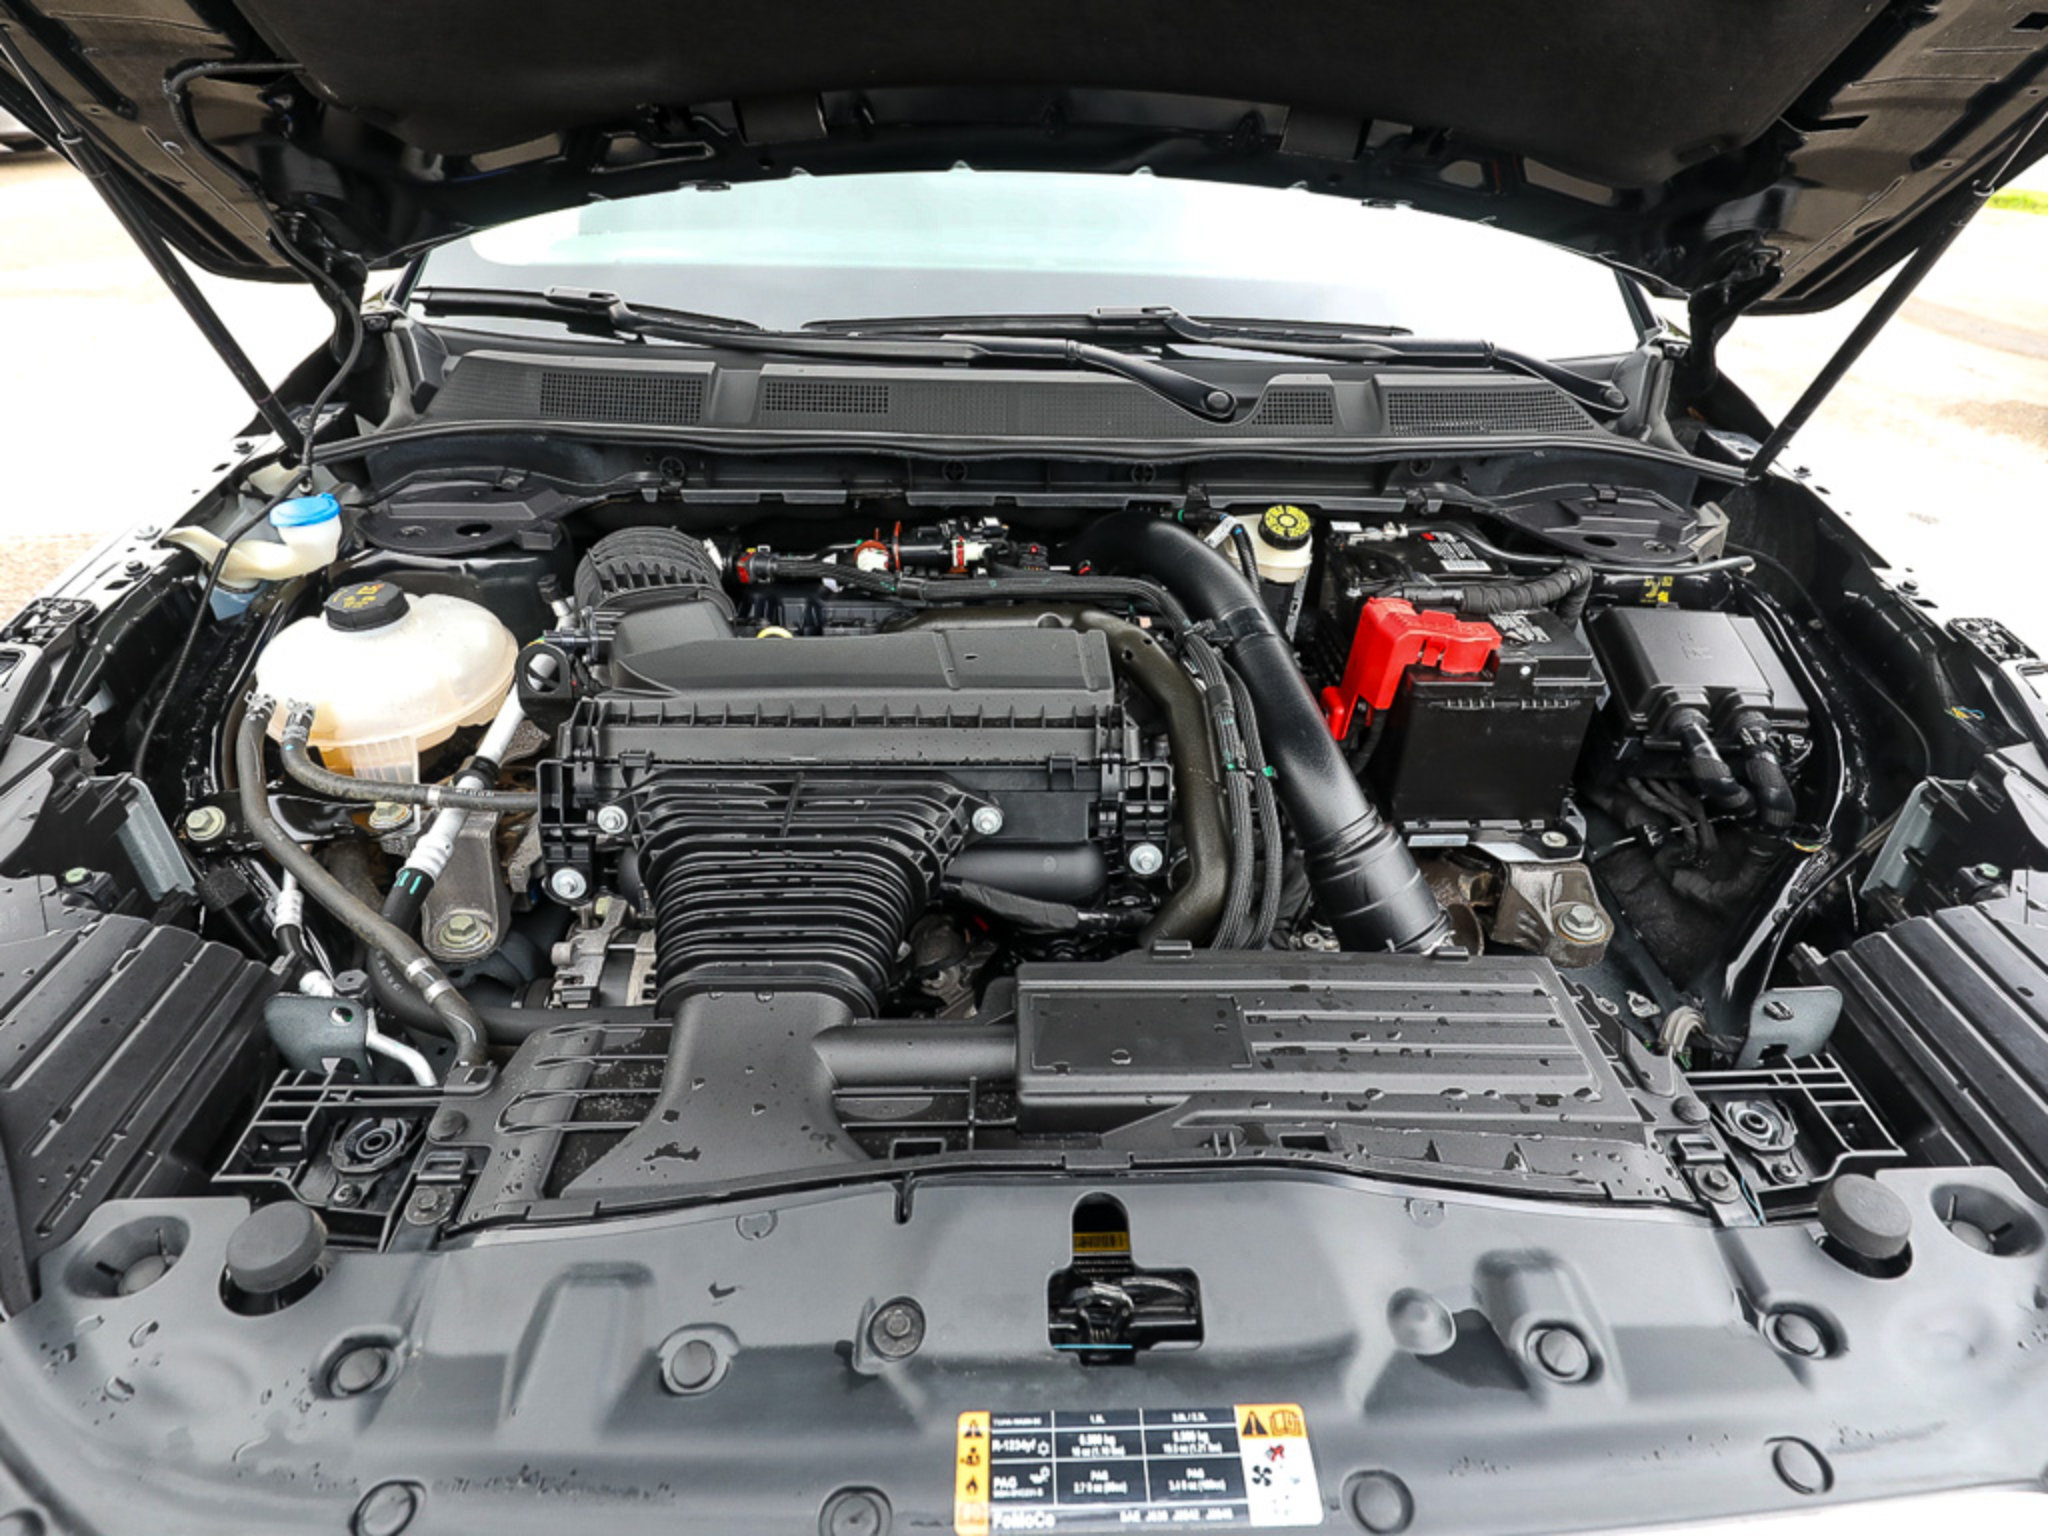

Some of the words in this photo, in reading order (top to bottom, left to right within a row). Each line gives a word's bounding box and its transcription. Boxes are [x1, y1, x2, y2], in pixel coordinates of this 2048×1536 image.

[991, 1438, 1037, 1453] R-1234yf
[1090, 1470, 1109, 1481] PAG
[1187, 1467, 1205, 1479] PAG
[993, 1475, 1018, 1489] PAG
[992, 1511, 1055, 1530] FoMoCo
[1119, 1509, 1141, 1523] SAE
